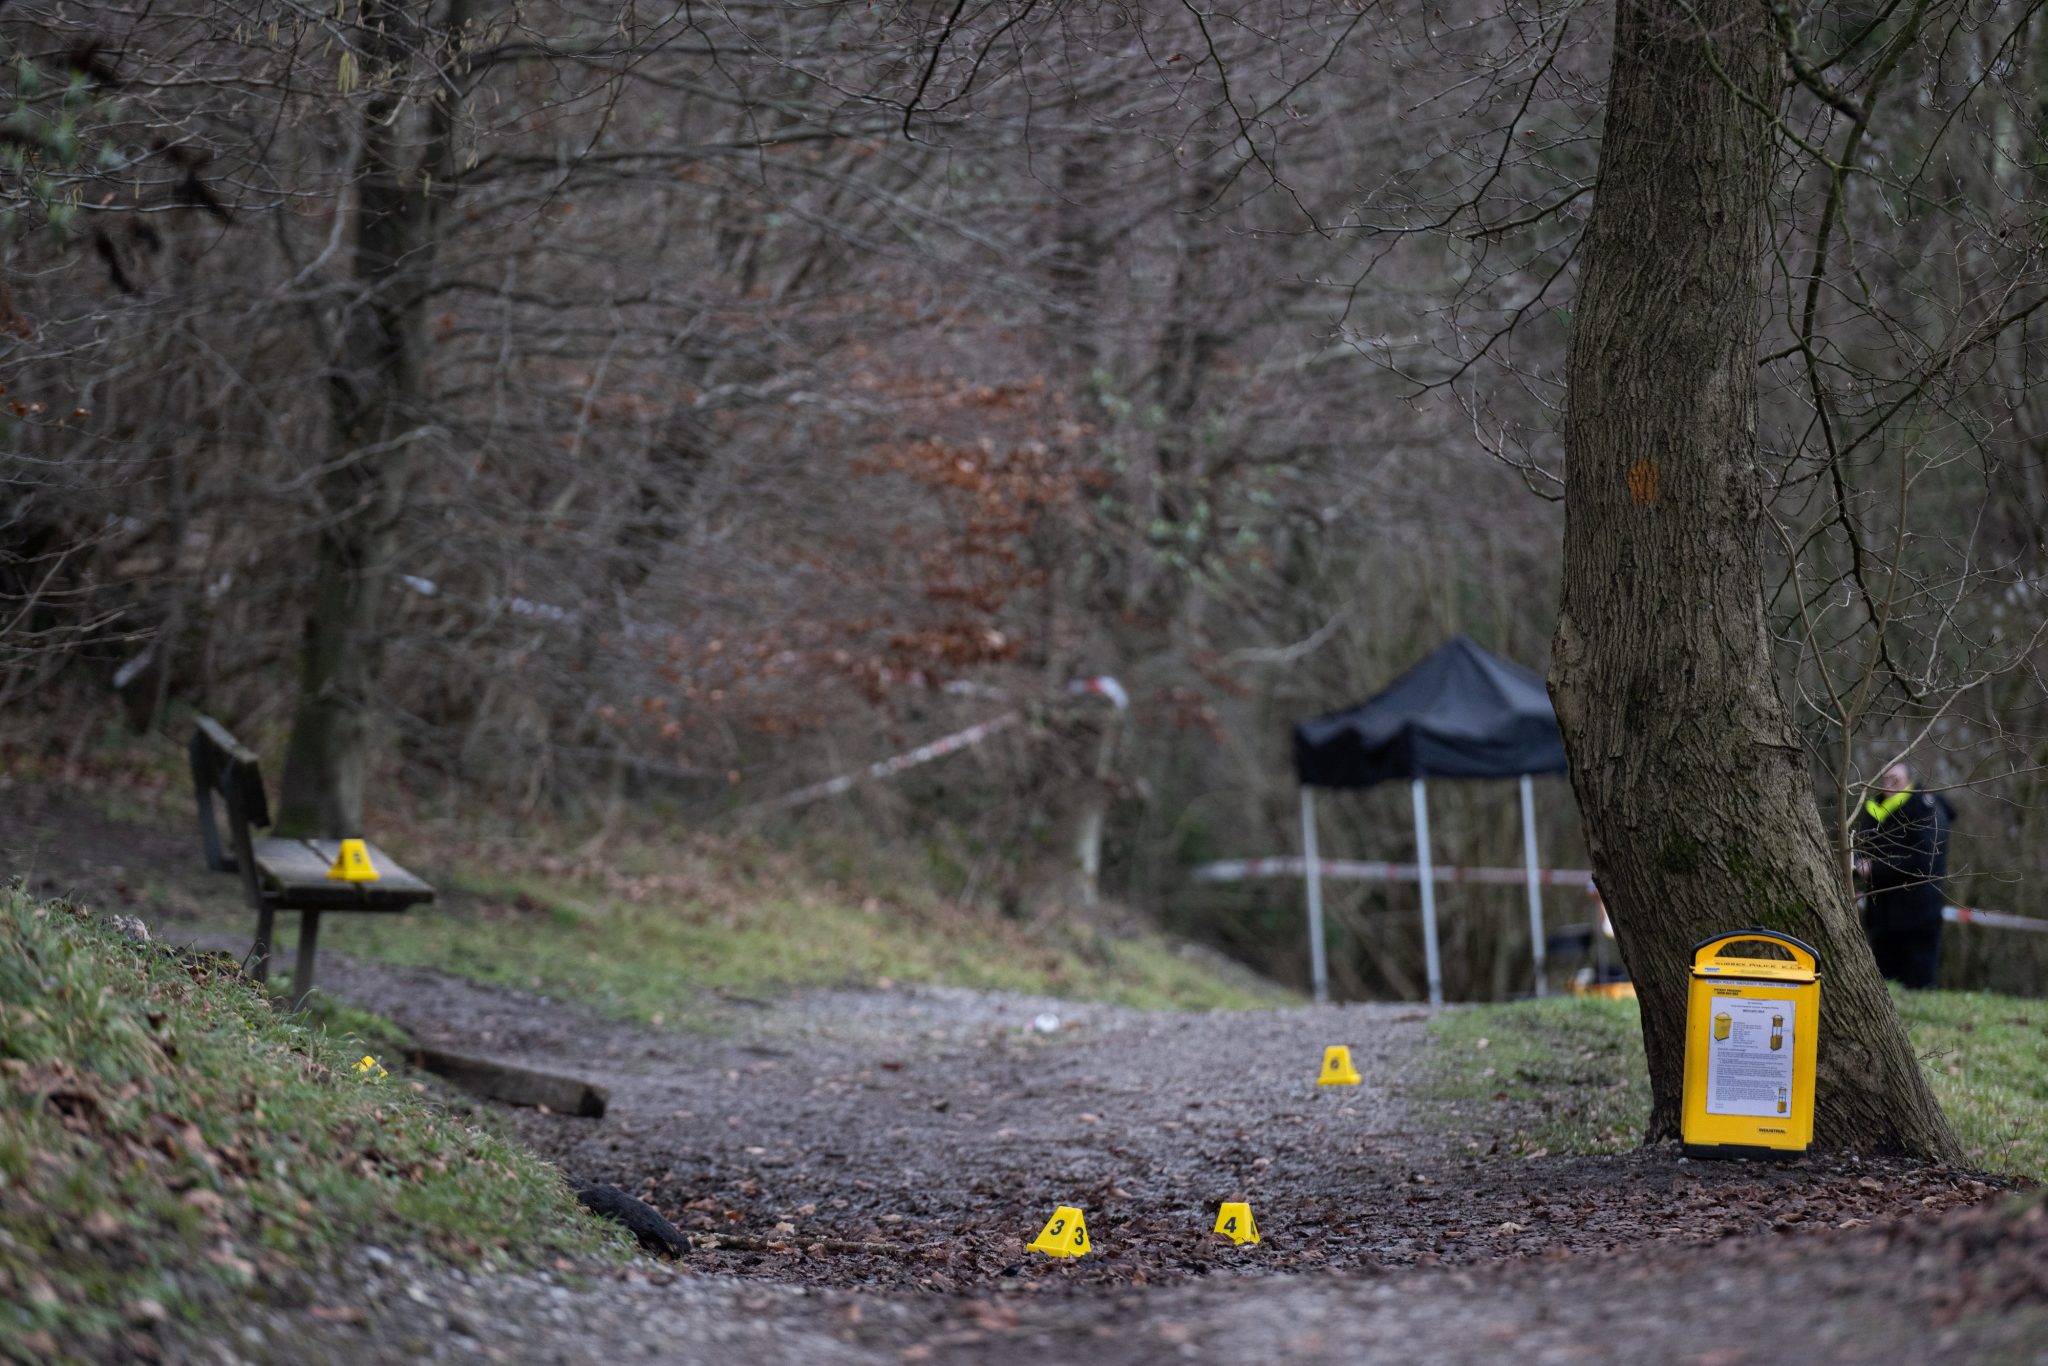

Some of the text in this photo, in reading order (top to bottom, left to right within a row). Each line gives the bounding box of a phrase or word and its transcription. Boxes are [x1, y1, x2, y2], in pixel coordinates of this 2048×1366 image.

[1050, 1219, 1065, 1236] 3
[1223, 1216, 1237, 1233] 4
[1074, 1226, 1084, 1246] 3
